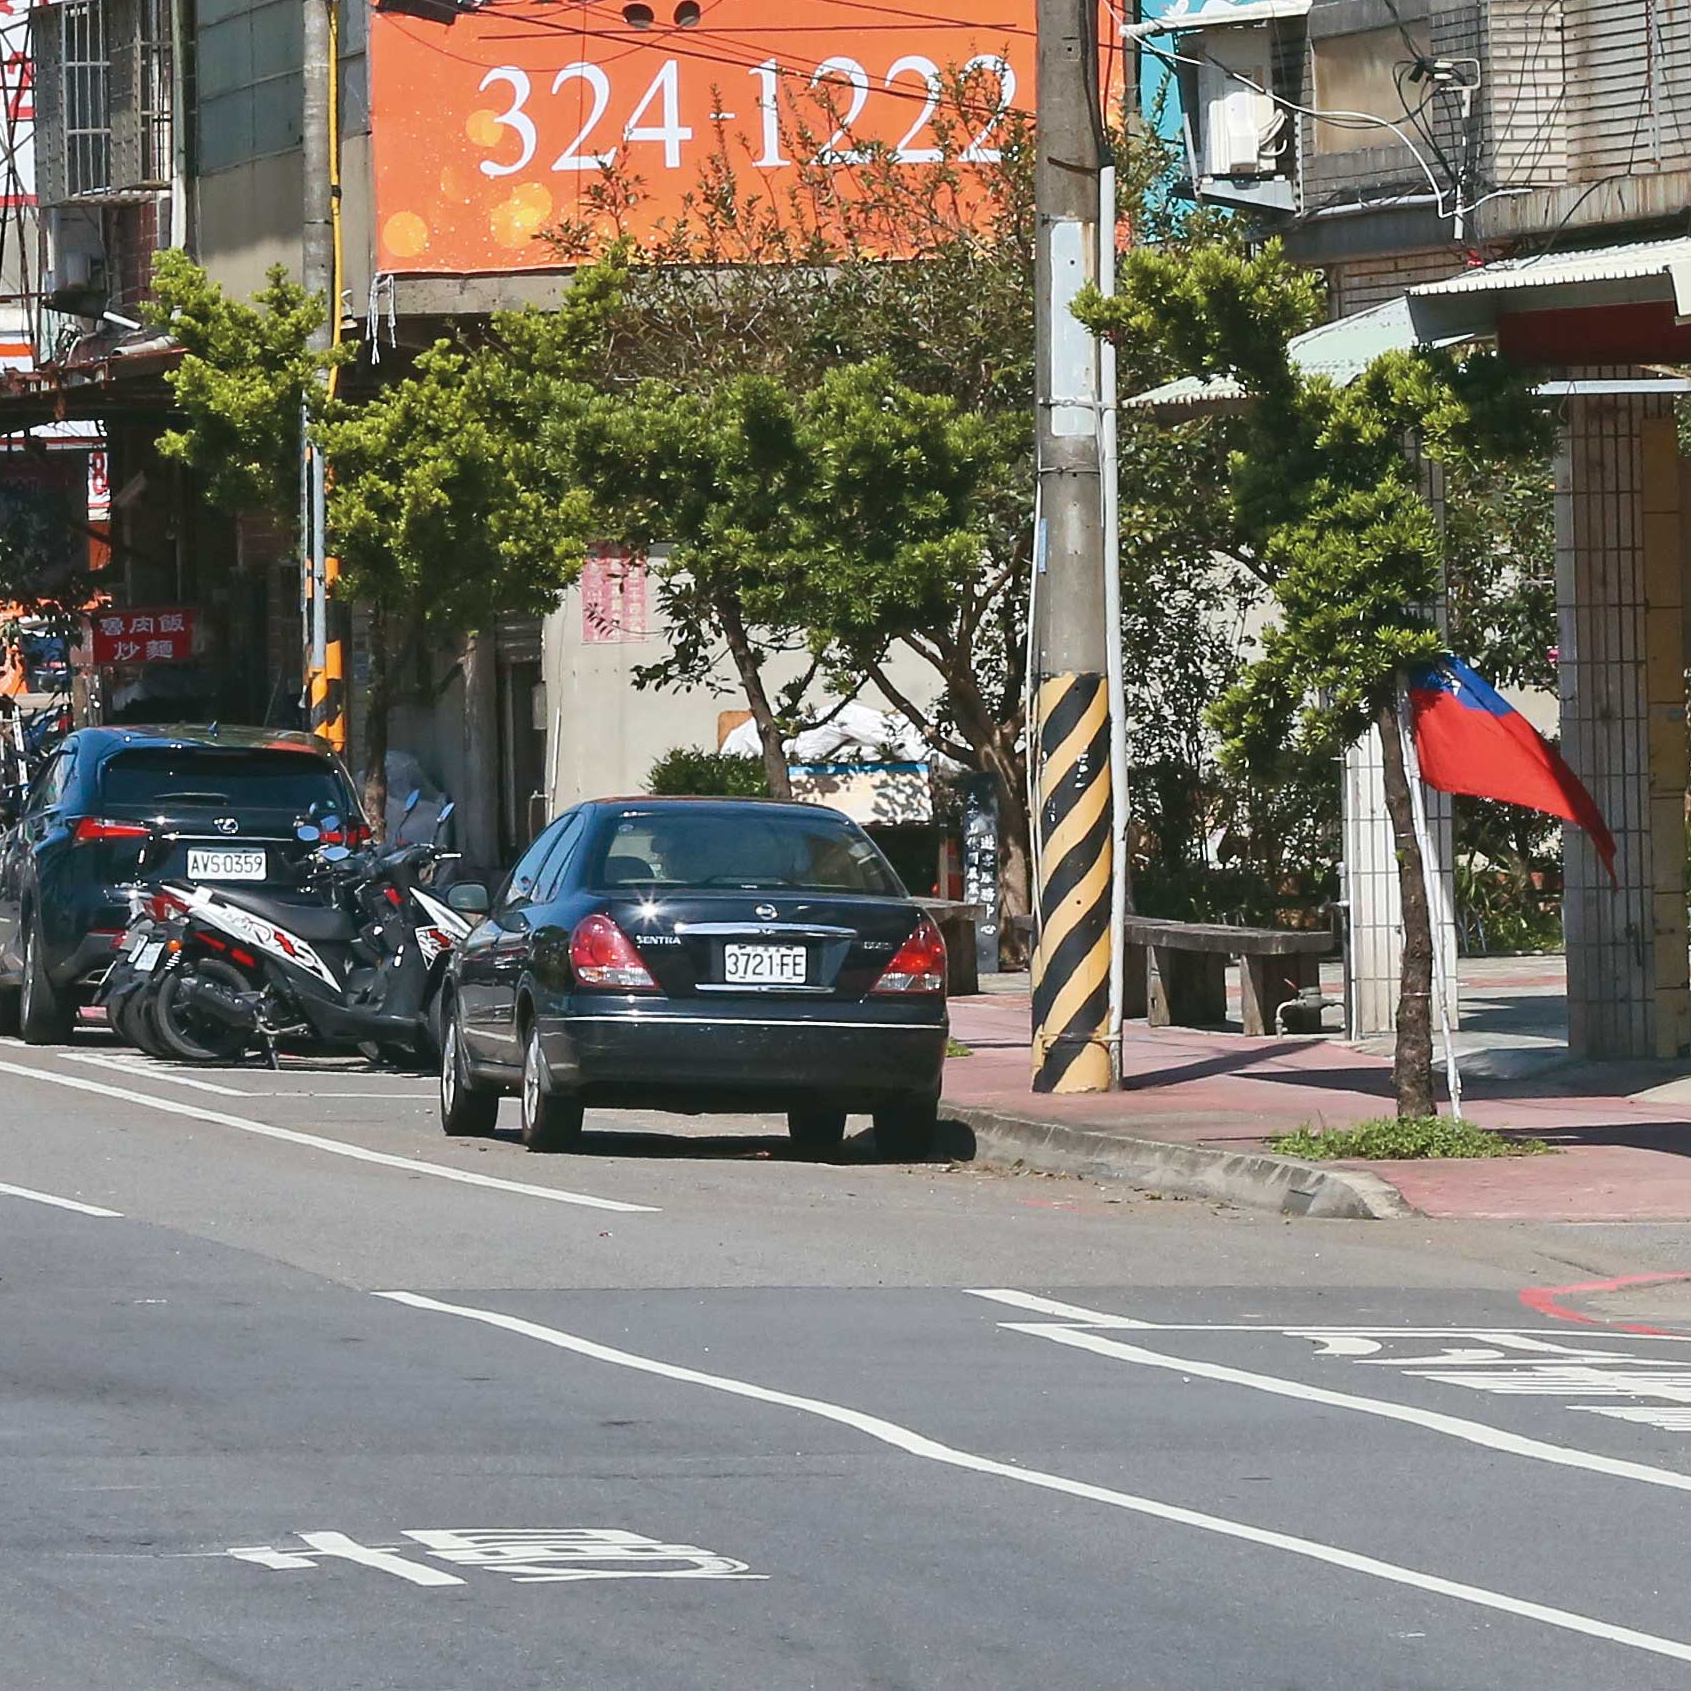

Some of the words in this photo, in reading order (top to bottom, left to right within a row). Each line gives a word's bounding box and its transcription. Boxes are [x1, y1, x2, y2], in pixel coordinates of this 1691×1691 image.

[478, 53, 1017, 177] 324-1222
[99, 613, 185, 636] 魯肉飯
[113, 640, 174, 662] 炒麵
[636, 935, 682, 946] SENTRA
